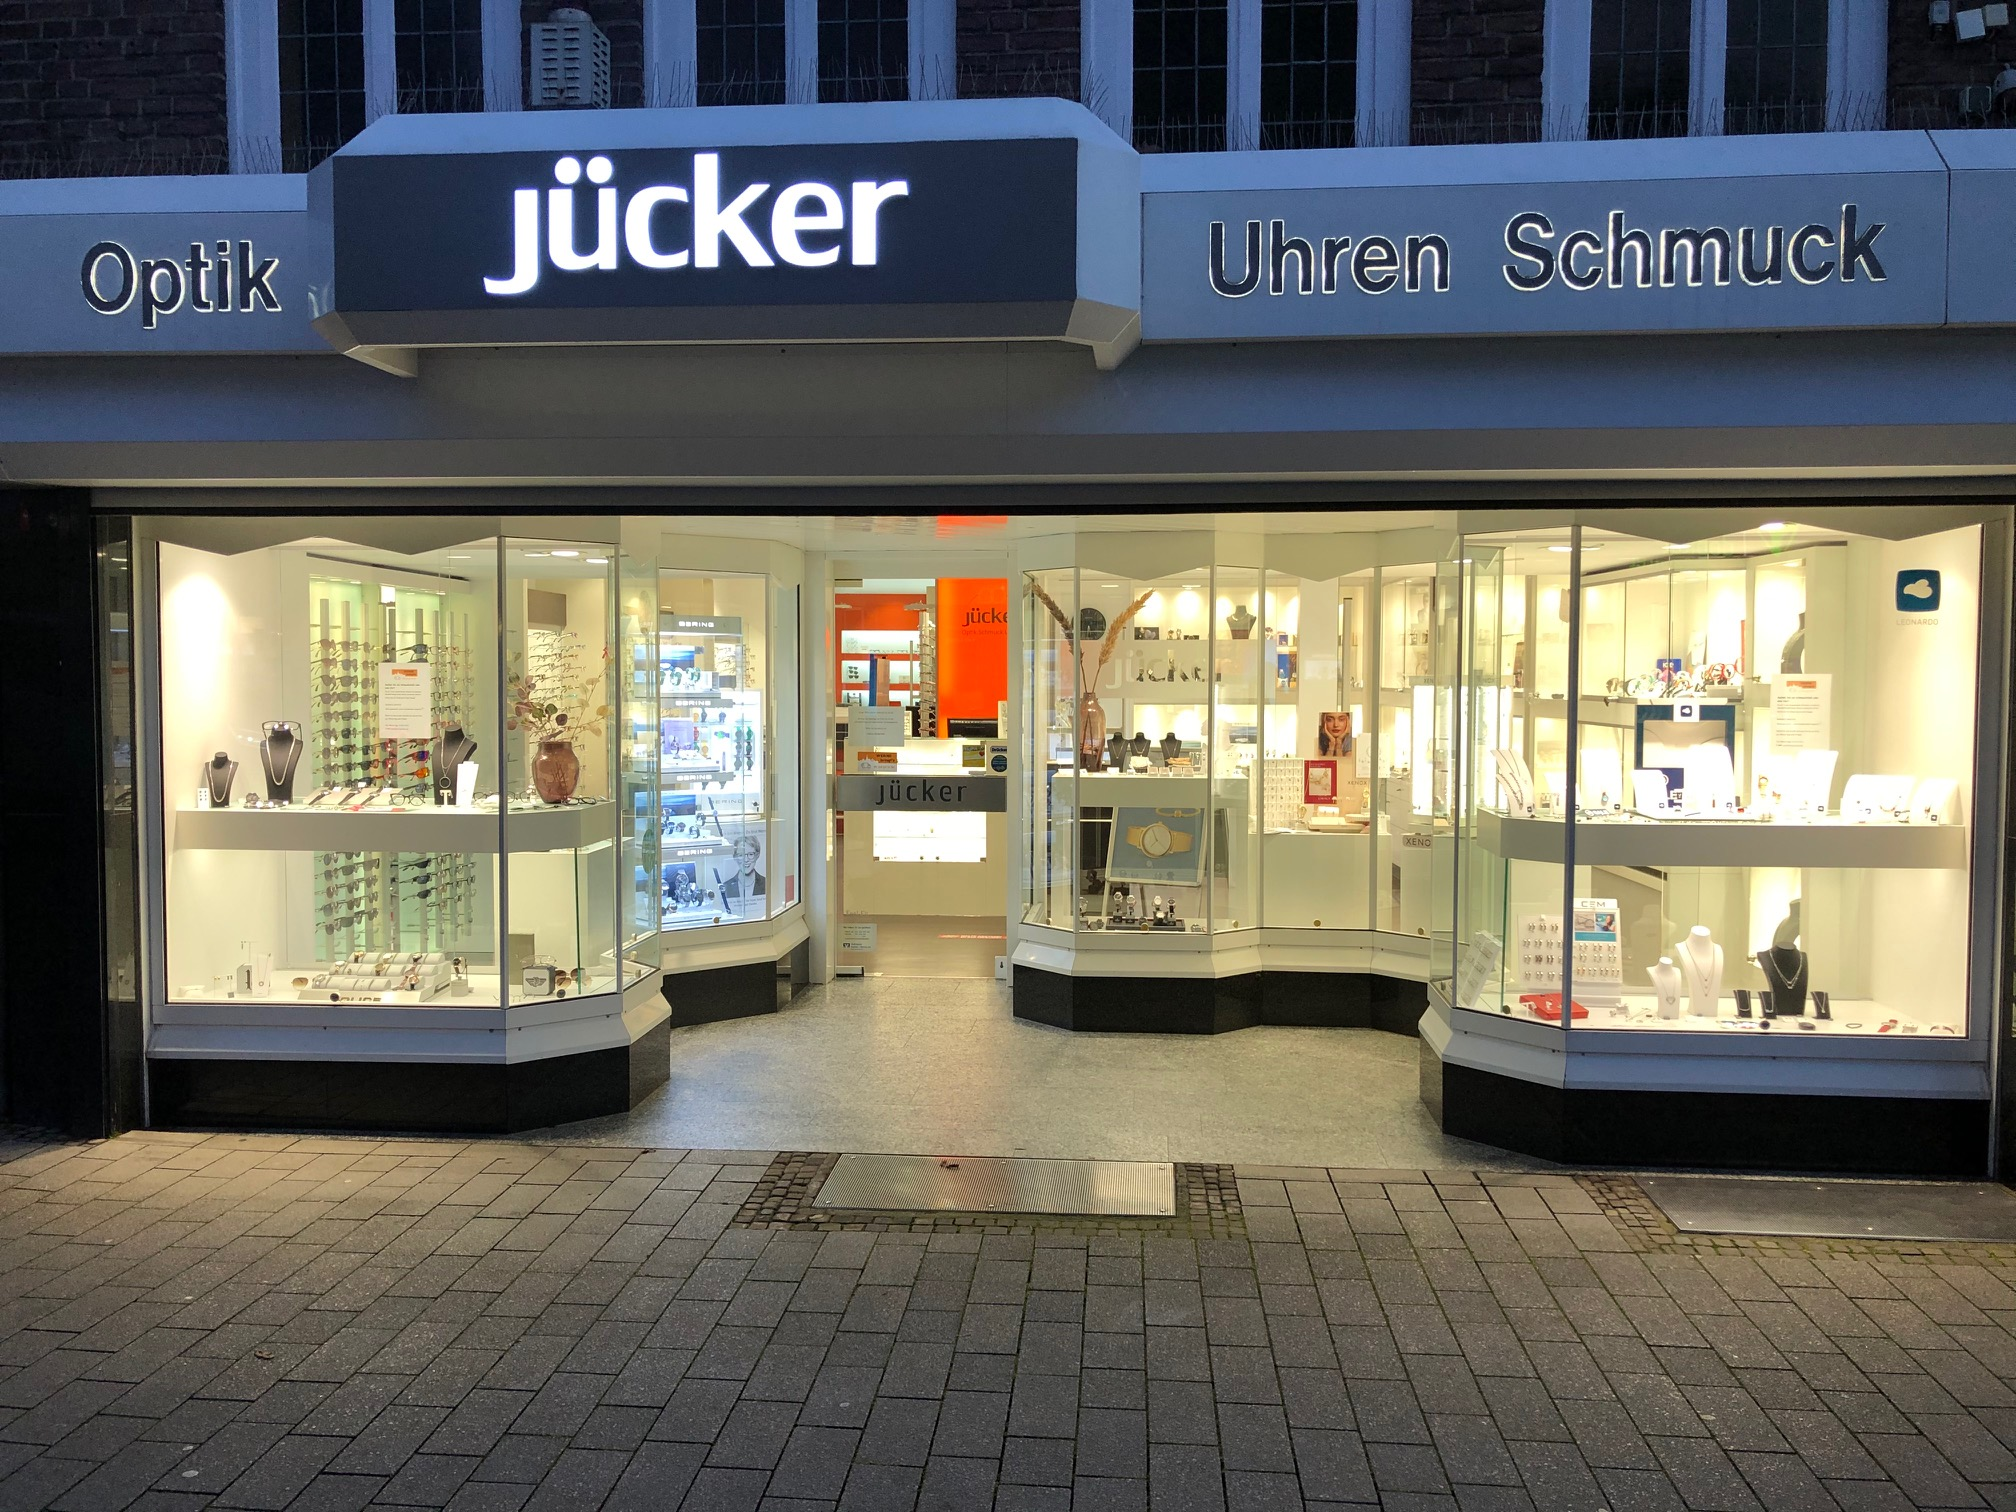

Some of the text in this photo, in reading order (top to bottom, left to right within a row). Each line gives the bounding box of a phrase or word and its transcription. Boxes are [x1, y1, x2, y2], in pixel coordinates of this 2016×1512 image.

[484, 153, 909, 296] jücker
[1208, 204, 1887, 298] Uhren Schmuck
[81, 240, 282, 330] Optik
[1896, 618, 1939, 626] LEONARDO
[876, 779, 967, 806] jücker
[1582, 900, 1606, 908] CEM
